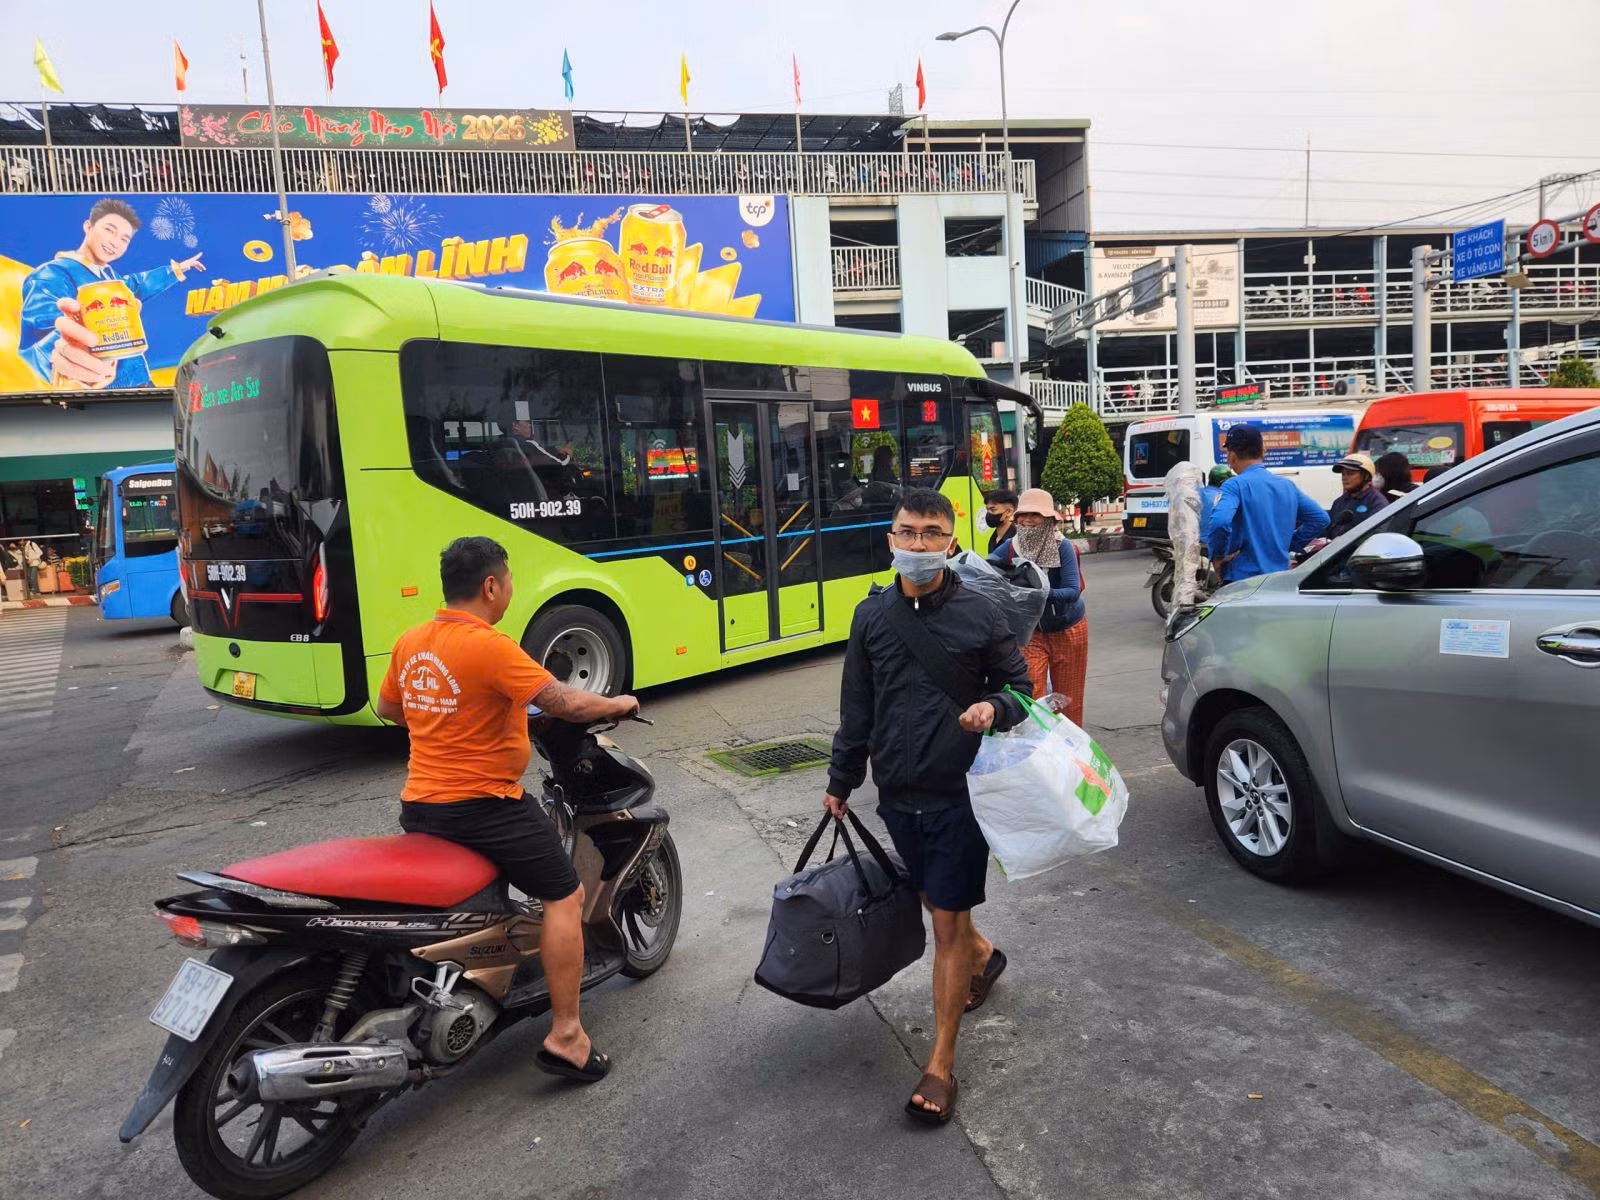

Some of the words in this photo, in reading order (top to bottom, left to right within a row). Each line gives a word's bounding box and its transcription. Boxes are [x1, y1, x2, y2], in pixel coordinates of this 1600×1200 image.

[461, 114, 526, 140] 2026
[746, 202, 770, 218] tcp
[1456, 236, 1466, 247] XE
[1467, 228, 1493, 243] KHÁCH
[415, 234, 529, 280] LĨNH
[1456, 251, 1466, 263] XE
[1474, 245, 1483, 258] TÔ
[1484, 242, 1500, 255] CON
[629, 257, 649, 273] Red
[651, 263, 672, 274] Bull
[1456, 267, 1466, 278] XE
[633, 284, 665, 293] EXTRA
[907, 382, 942, 392] VINBUS
[128, 478, 173, 489] SaigonBus
[509, 499, 581, 519] 50H-902.39
[206, 564, 247, 582] 50H-902.39
[470, 944, 507, 955] SUZUKI
